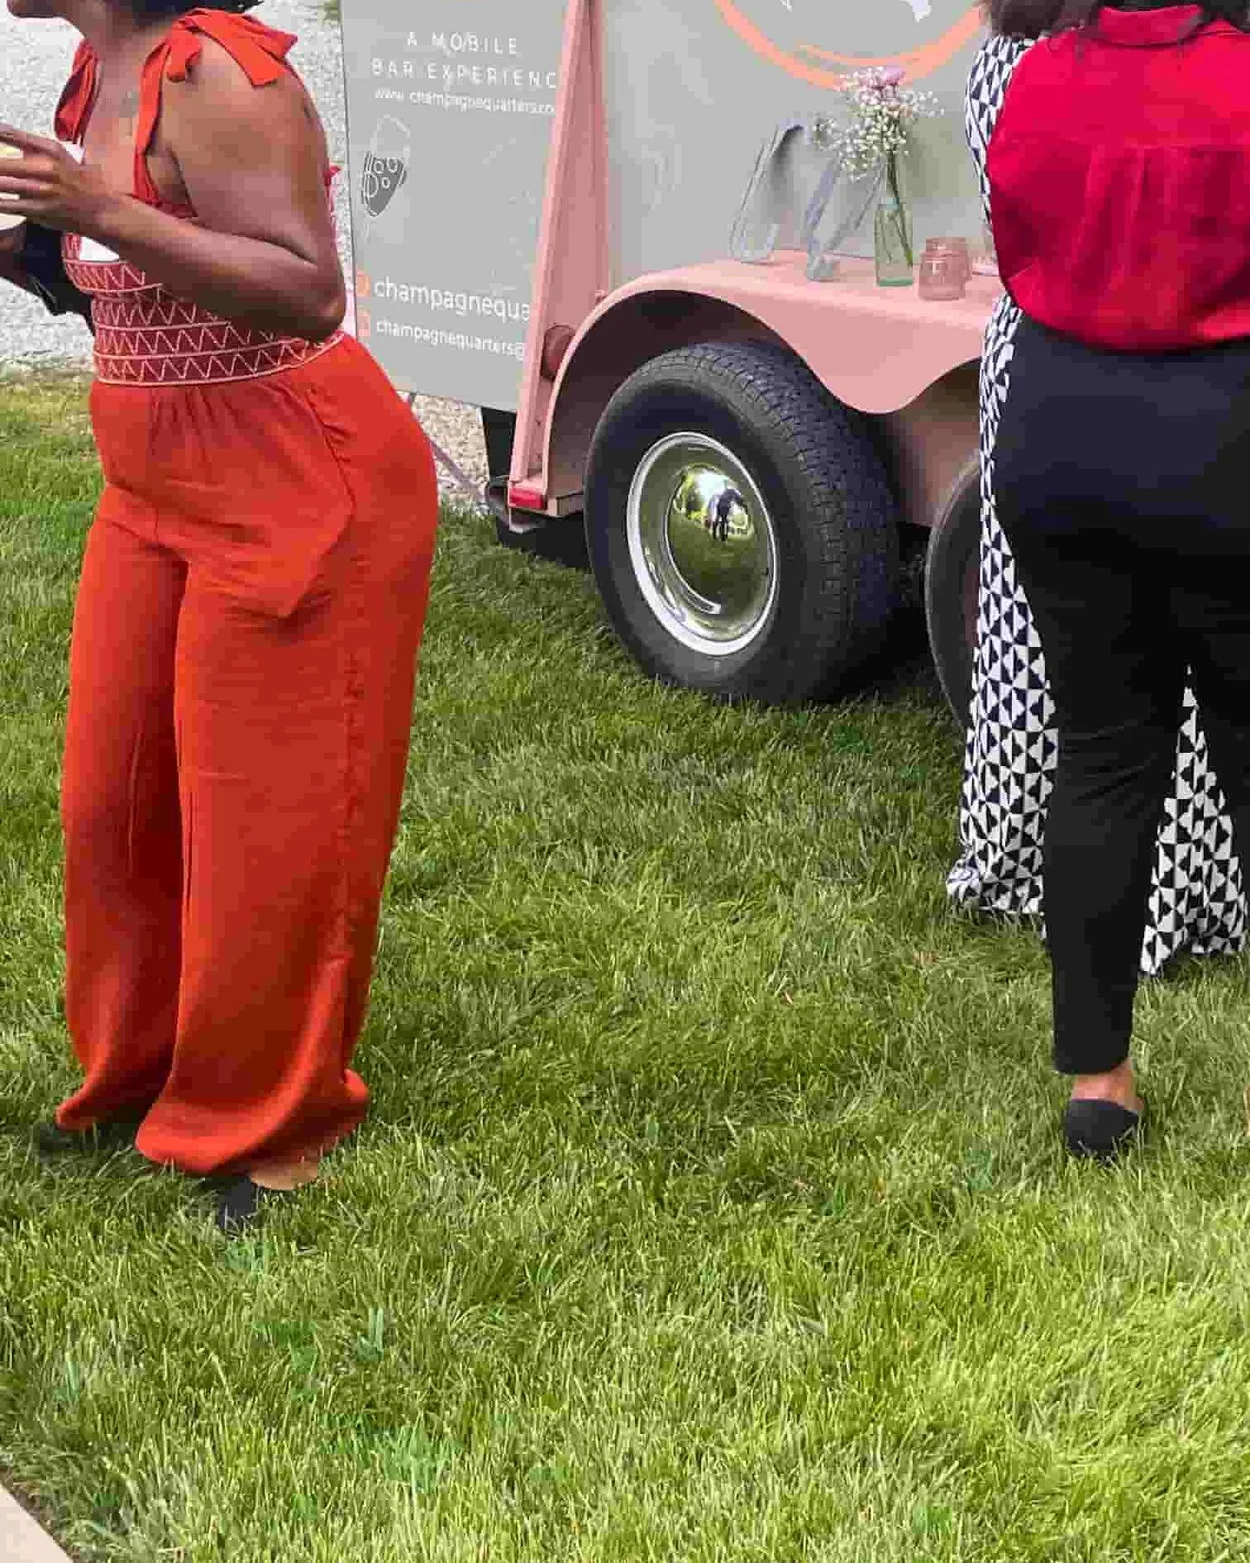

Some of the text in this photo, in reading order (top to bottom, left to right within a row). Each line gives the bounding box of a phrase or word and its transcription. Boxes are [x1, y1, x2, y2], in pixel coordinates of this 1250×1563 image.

[407, 31, 518, 56] A MOBILE
[371, 57, 557, 90] BAR EXPERIENC
[374, 276, 531, 324] champagnequa
[376, 318, 526, 361] champagnequarters@
